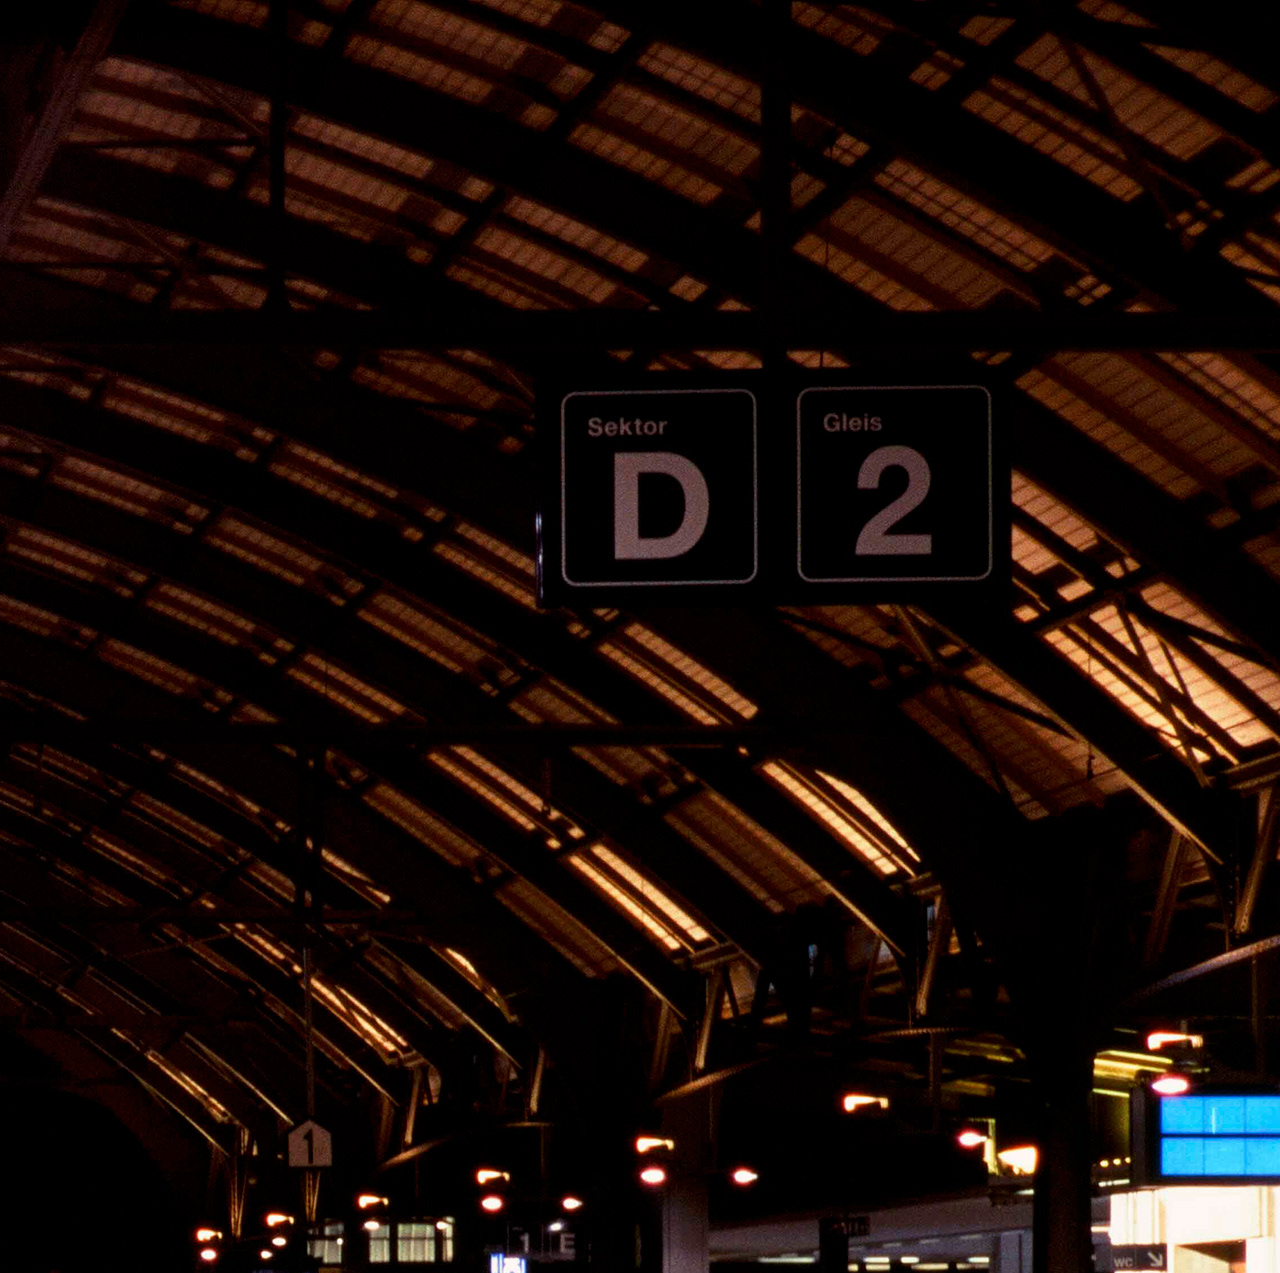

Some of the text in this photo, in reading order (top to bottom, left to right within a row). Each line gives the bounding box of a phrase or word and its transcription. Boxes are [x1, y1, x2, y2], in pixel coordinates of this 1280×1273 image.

[587, 417, 668, 437] Sektor
[823, 413, 883, 433] Gleis
[614, 452, 710, 560] D
[855, 445, 933, 556] 2
[303, 1128, 314, 1165] 1
